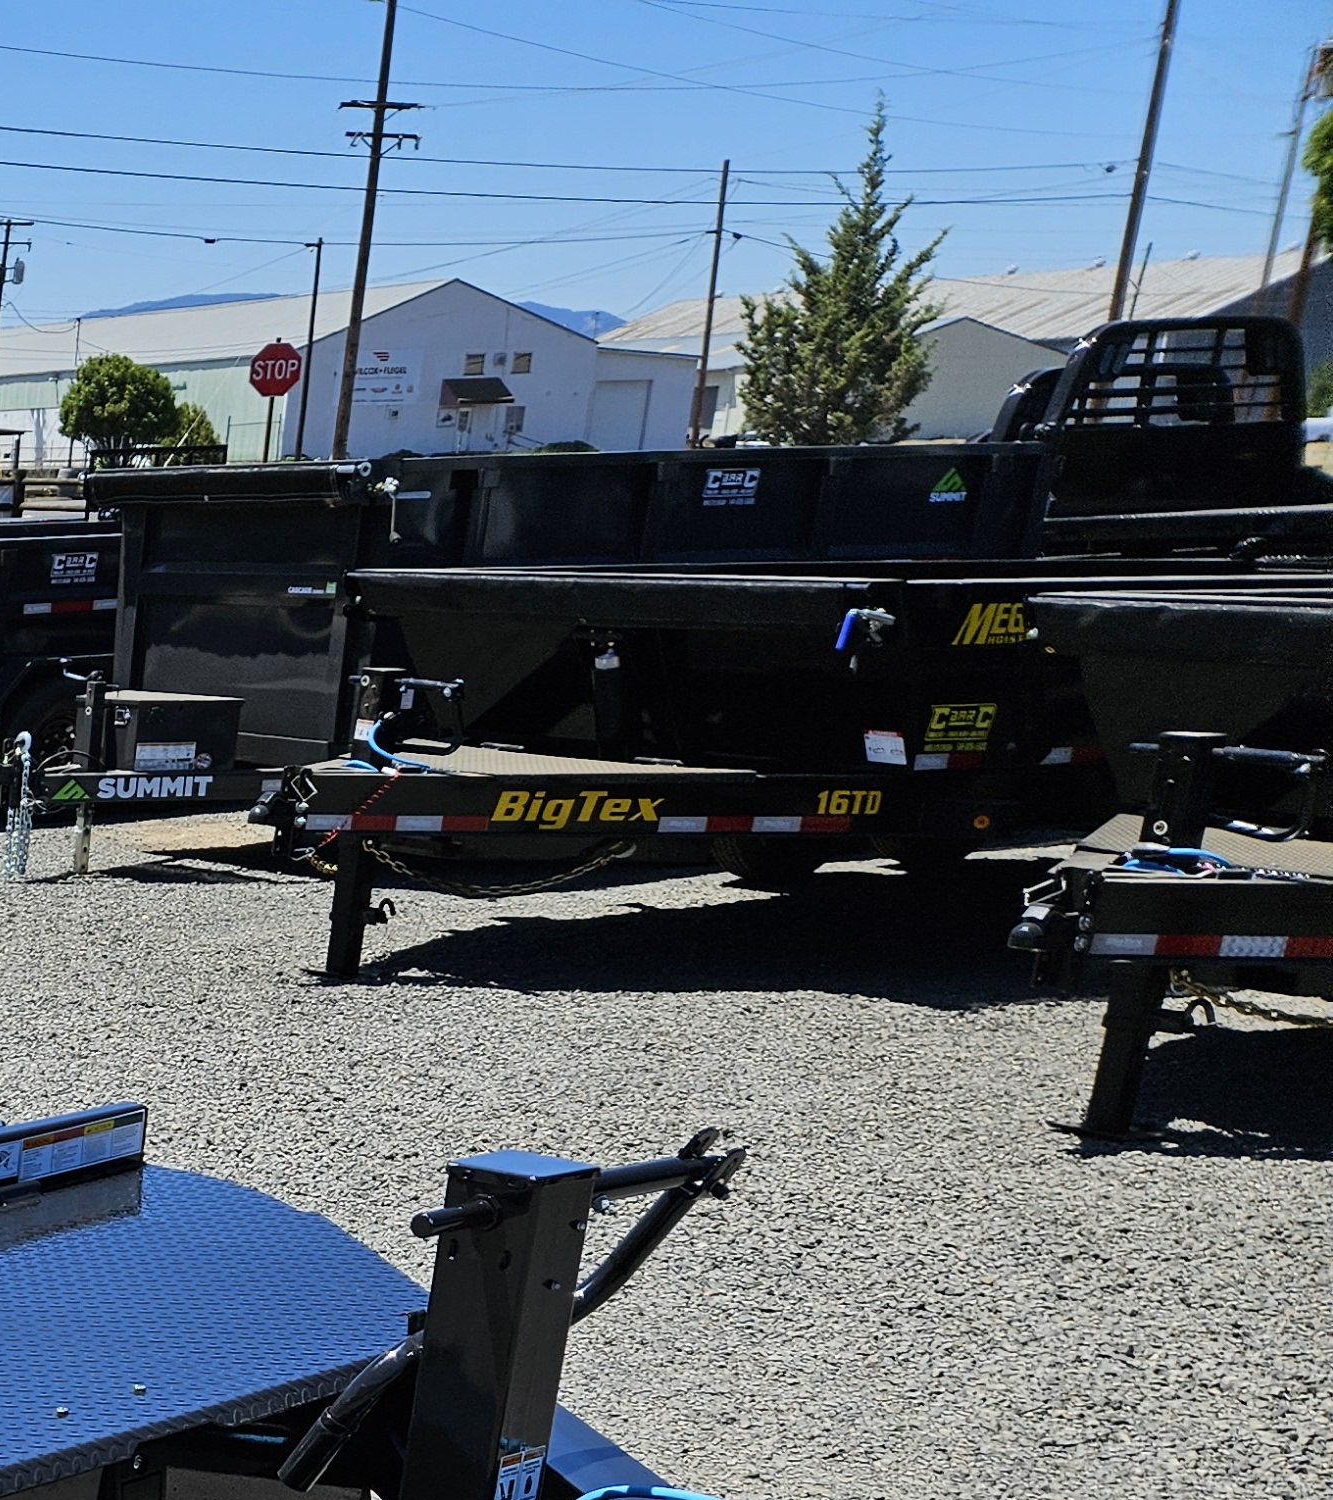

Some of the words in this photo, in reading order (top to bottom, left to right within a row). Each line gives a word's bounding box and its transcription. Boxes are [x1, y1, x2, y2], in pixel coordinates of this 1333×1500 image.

[253, 360, 299, 380] STOP
[384, 367, 407, 375] FLEGEL
[707, 471, 723, 488] C
[743, 470, 760, 488] C
[929, 491, 968, 502] SUMMIT
[53, 555, 66, 570] C
[85, 553, 97, 568] C
[951, 603, 1025, 645] MEG
[930, 707, 951, 730] C
[975, 706, 994, 728] C
[96, 776, 213, 799] SUMMIT
[490, 791, 665, 830] BigTex
[816, 790, 881, 815] 16TD
